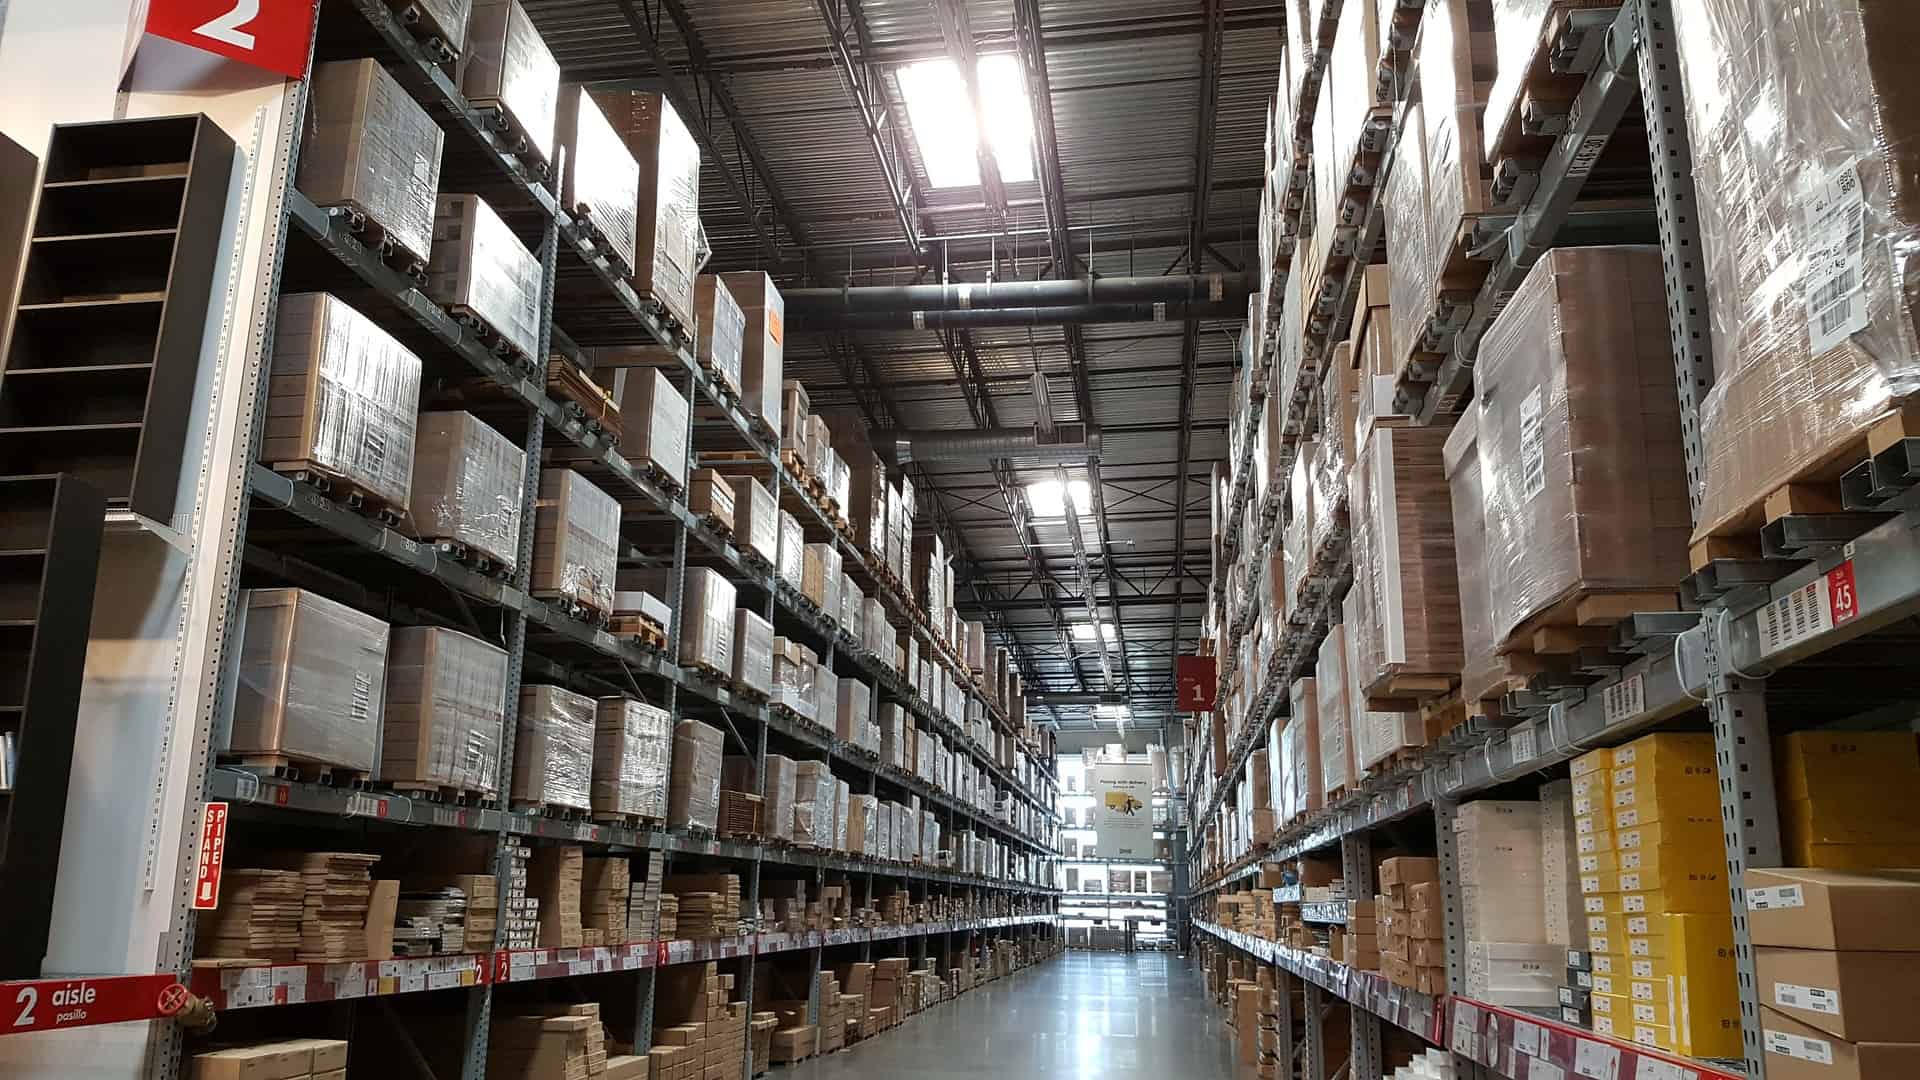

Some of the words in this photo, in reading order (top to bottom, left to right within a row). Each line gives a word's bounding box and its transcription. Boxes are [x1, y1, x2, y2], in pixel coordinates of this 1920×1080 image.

[192, 0, 260, 50] 2
[1836, 584, 1852, 610] 45
[1192, 684, 1205, 701] 1
[200, 810, 215, 879] STAND
[212, 809, 225, 865] PIPE
[475, 964, 482, 984] 2
[501, 961, 508, 981] 2
[13, 986, 38, 1027] 2
[52, 982, 96, 1006] aisle
[56, 1008, 87, 1024] pasillo
